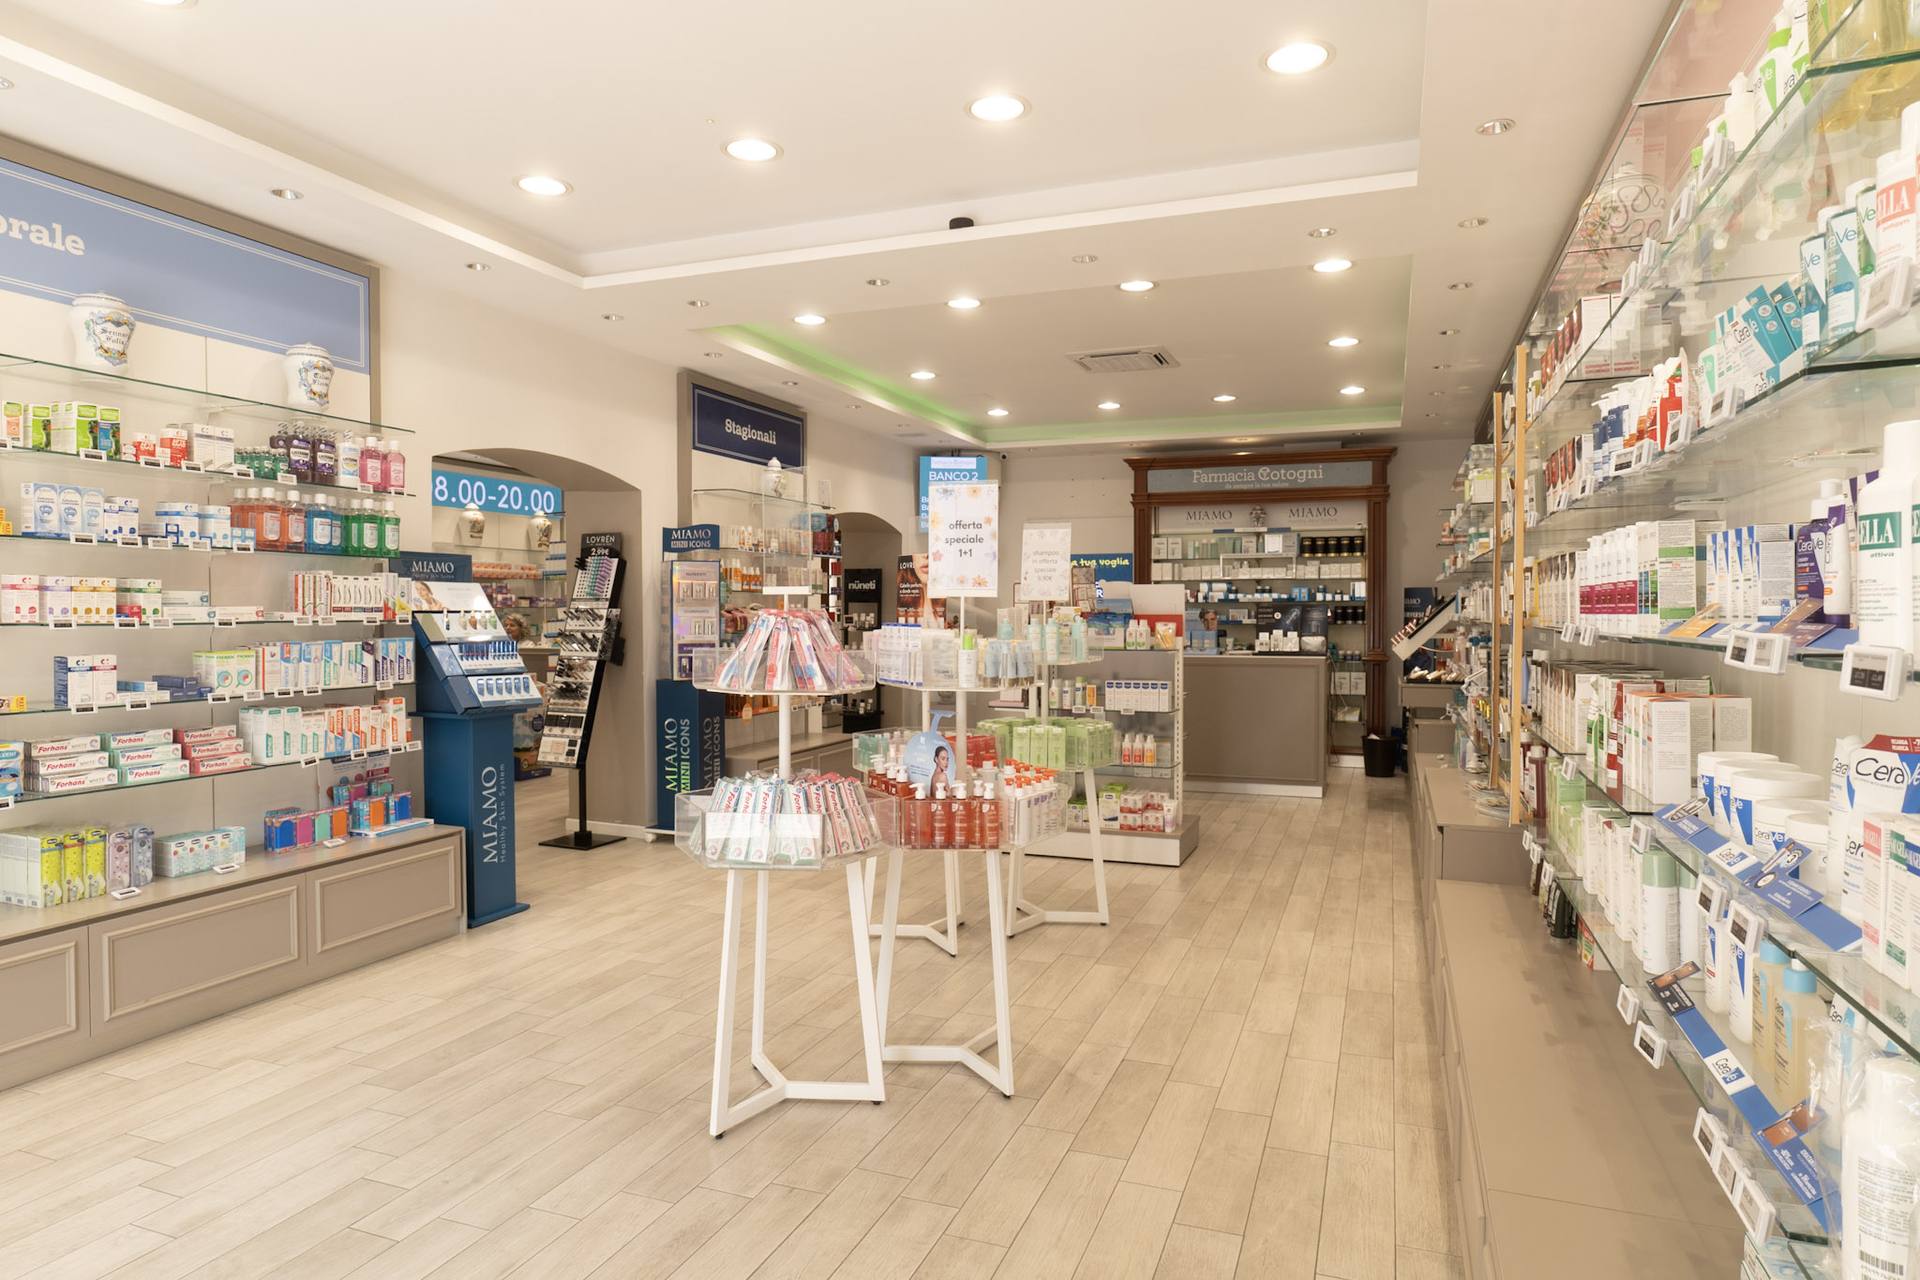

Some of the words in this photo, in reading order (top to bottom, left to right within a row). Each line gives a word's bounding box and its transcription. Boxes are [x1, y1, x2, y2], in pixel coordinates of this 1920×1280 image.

[725, 418, 777, 445] Stagionali
[929, 471, 970, 481] BANCO
[971, 471, 978, 481] 2
[1192, 469, 1255, 483] Farmacia
[1258, 465, 1324, 482] Cotogni
[1186, 510, 1232, 521] MIAMO
[1288, 506, 1338, 519] MIAMO
[949, 520, 983, 530] offerta
[671, 529, 711, 539] MIAMO
[945, 534, 984, 546] speciale
[958, 549, 973, 558] 1+1
[411, 561, 455, 574] MIAMO
[1079, 558, 1096, 567] tua
[1099, 556, 1130, 568] voglia
[848, 579, 876, 590] nüneti
[117, 736, 144, 745] Forhans
[680, 718, 690, 759] ICONS
[38, 744, 68, 753] Forhans
[704, 718, 713, 789] MIAMO
[126, 753, 152, 762] Forhans
[664, 718, 678, 792] MIAMO
[46, 762, 76, 770] Forhans
[134, 769, 160, 778] Forhans
[56, 780, 85, 789] Forhans
[499, 764, 507, 796] System
[481, 766, 498, 863] MIAMO
[499, 825, 507, 863] Healthy
